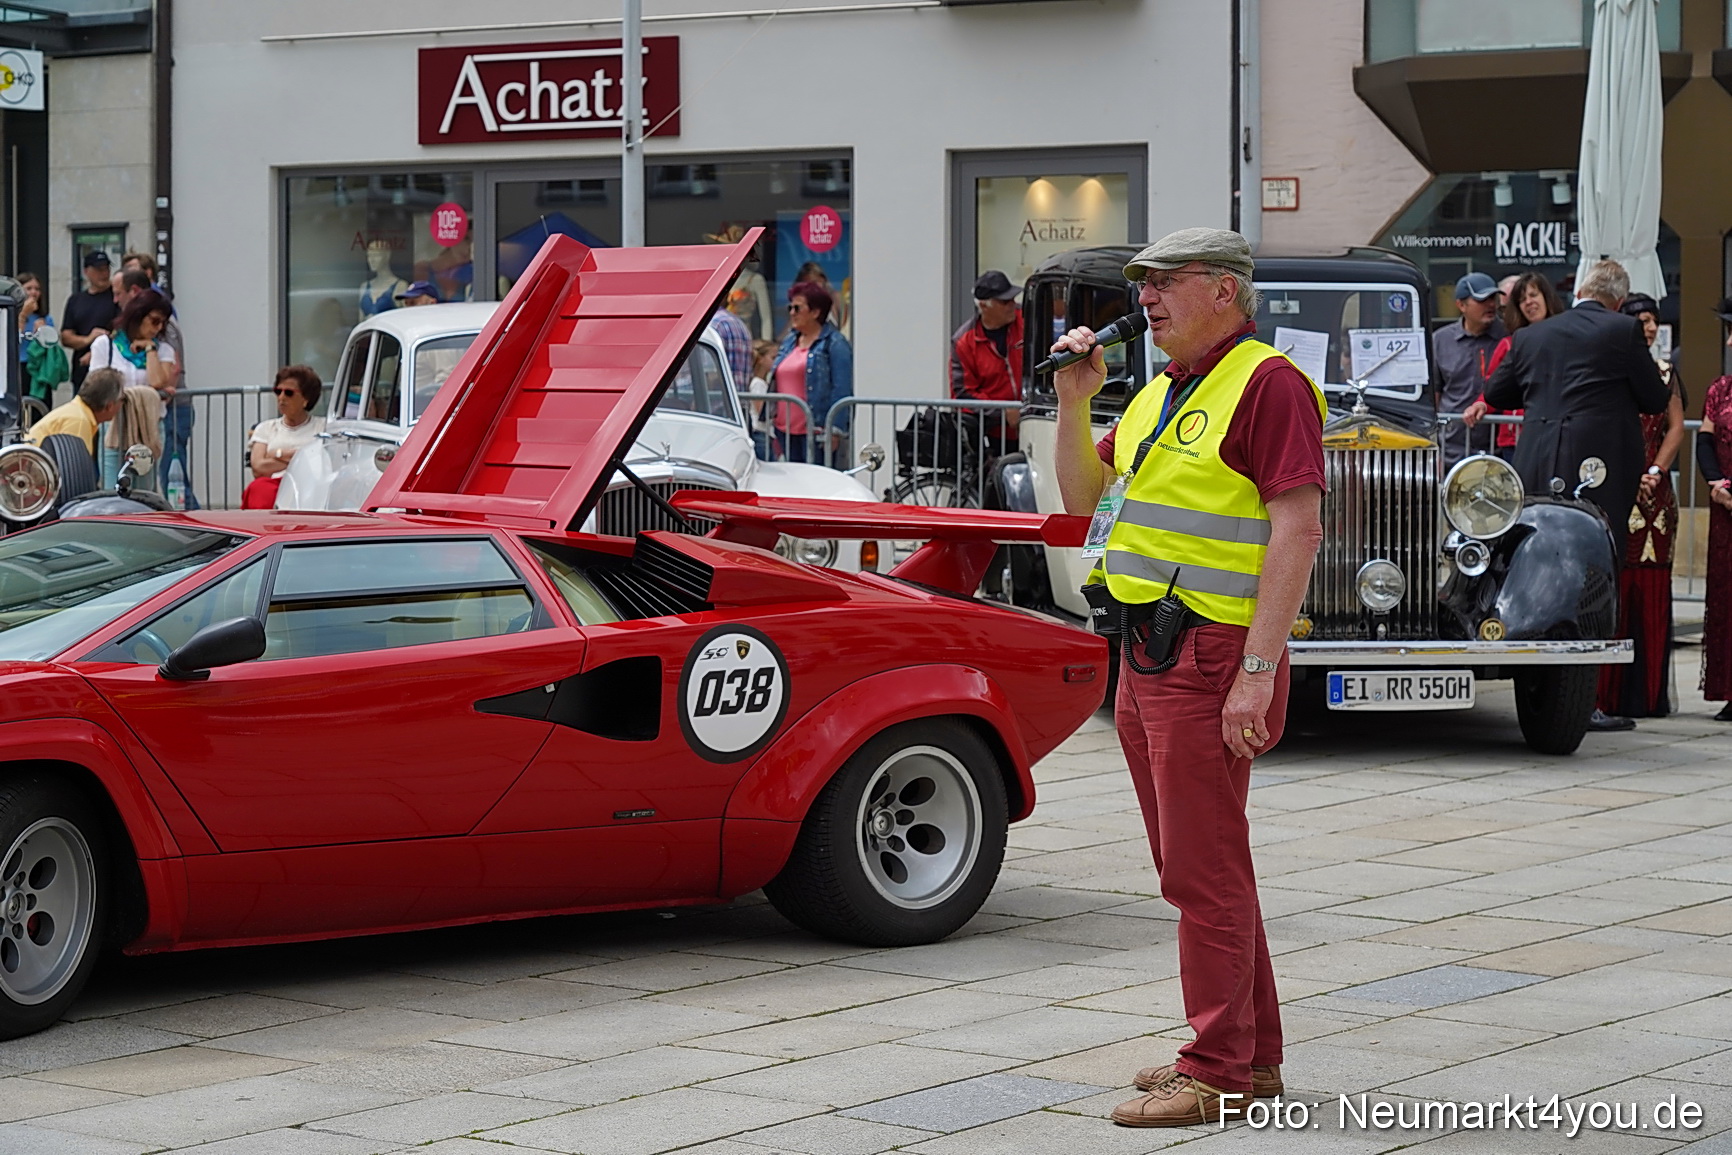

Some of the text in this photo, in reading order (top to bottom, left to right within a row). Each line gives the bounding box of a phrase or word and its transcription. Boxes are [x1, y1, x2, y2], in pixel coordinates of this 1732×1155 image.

[808, 213, 828, 233] 100
[1019, 220, 1086, 241] Achatz
[1392, 234, 1472, 248] Willkommen
[1475, 233, 1492, 246] im
[1495, 222, 1566, 257] RACKL
[1386, 340, 1411, 352] 427
[693, 667, 775, 717] 038
[1333, 691, 1339, 699] D
[1344, 677, 1470, 700] EI RR 550H
